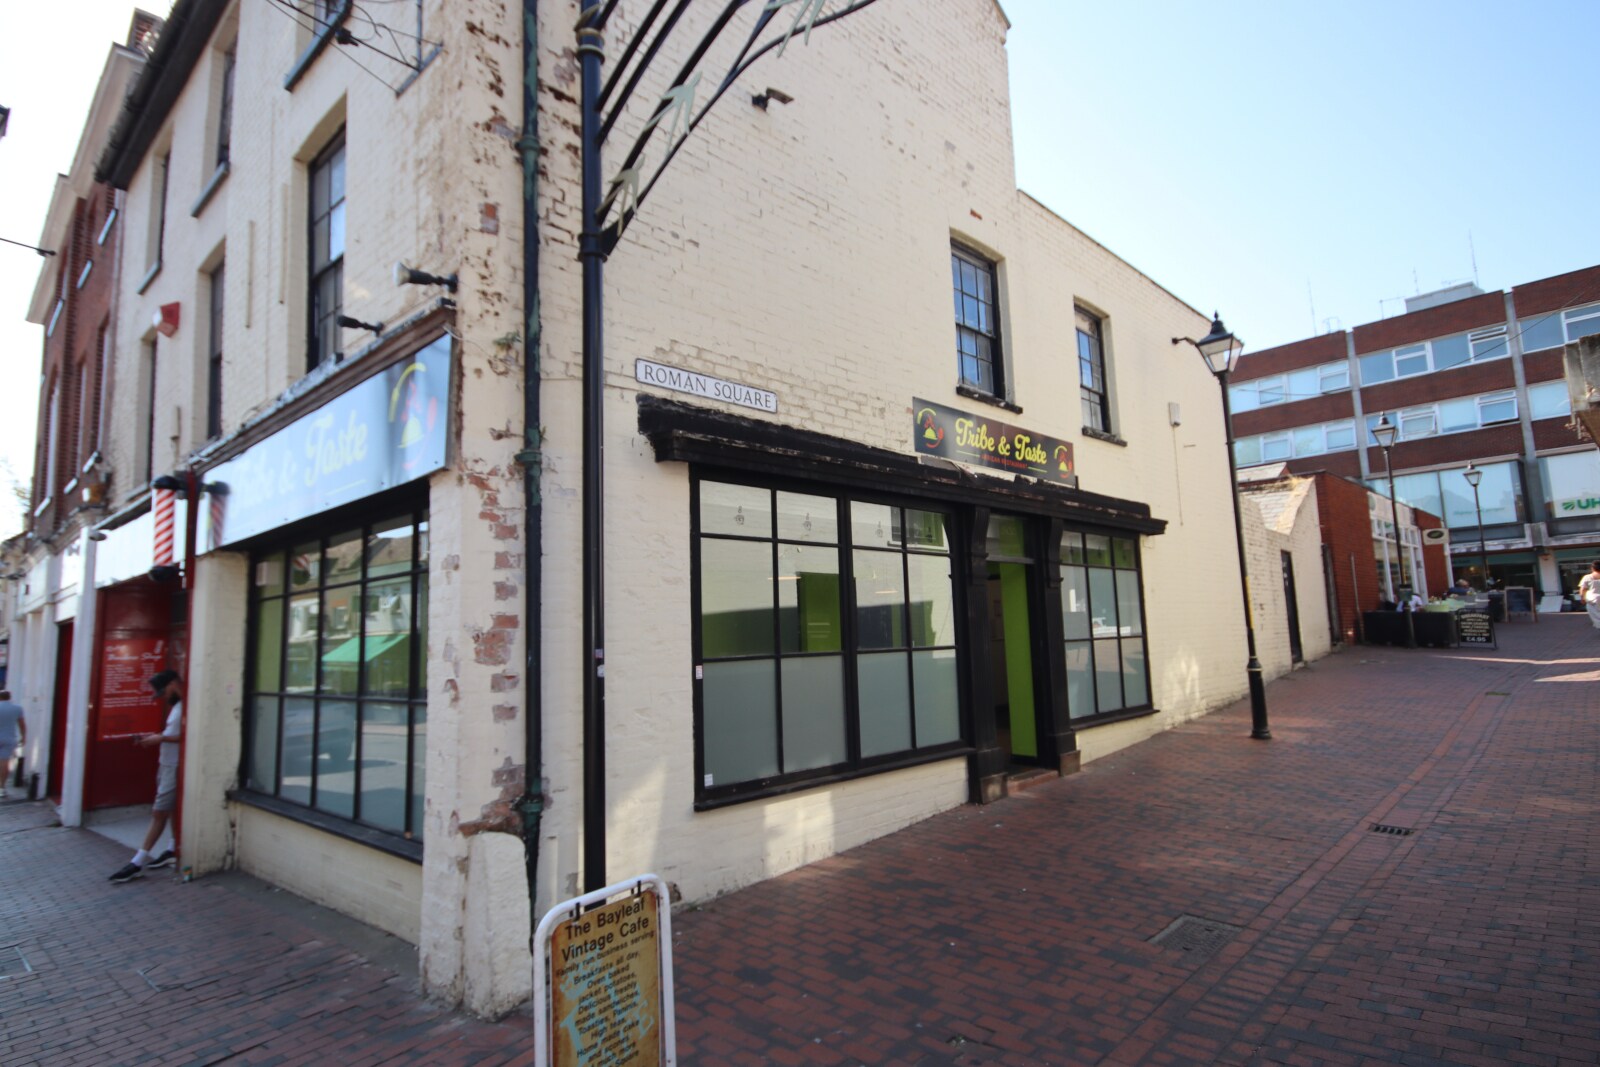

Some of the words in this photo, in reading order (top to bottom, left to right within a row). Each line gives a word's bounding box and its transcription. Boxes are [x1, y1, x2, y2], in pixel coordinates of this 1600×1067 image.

[644, 364, 706, 392] ROMAN
[714, 382, 772, 409] SQUARE
[303, 409, 369, 487] Taste
[955, 417, 995, 452] Tribe
[997, 436, 1011, 457] &
[1014, 433, 1048, 465] Taste
[562, 932, 614, 962] Vintage
[619, 917, 649, 938] Cafe
[565, 921, 591, 940] The
[597, 897, 645, 928] Bayleaf
[556, 963, 580, 977] Family
[597, 942, 628, 960] business
[631, 930, 655, 944] serving
